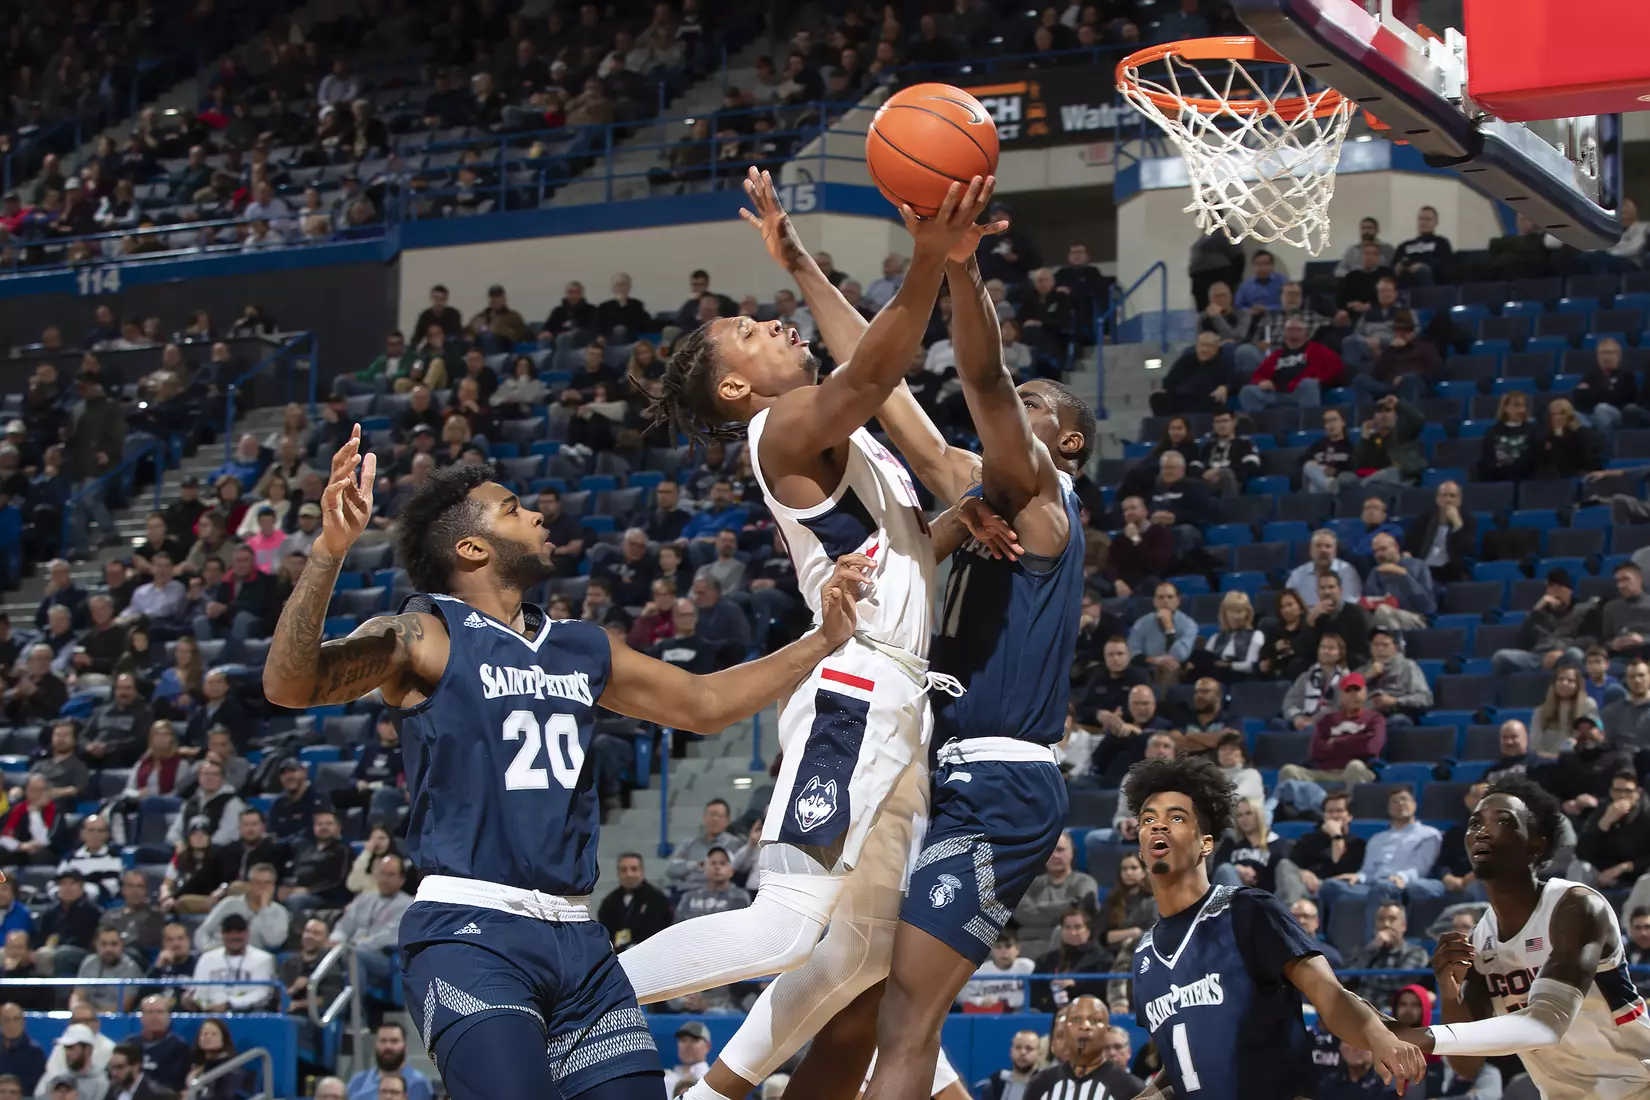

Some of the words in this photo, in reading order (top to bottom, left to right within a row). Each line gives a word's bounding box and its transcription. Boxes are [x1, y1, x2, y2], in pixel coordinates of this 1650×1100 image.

[981, 97, 1021, 122] CH
[779, 184, 817, 212] 15
[76, 269, 121, 295] 114
[502, 710, 585, 791] 20
[1172, 1022, 1201, 1093] 1
